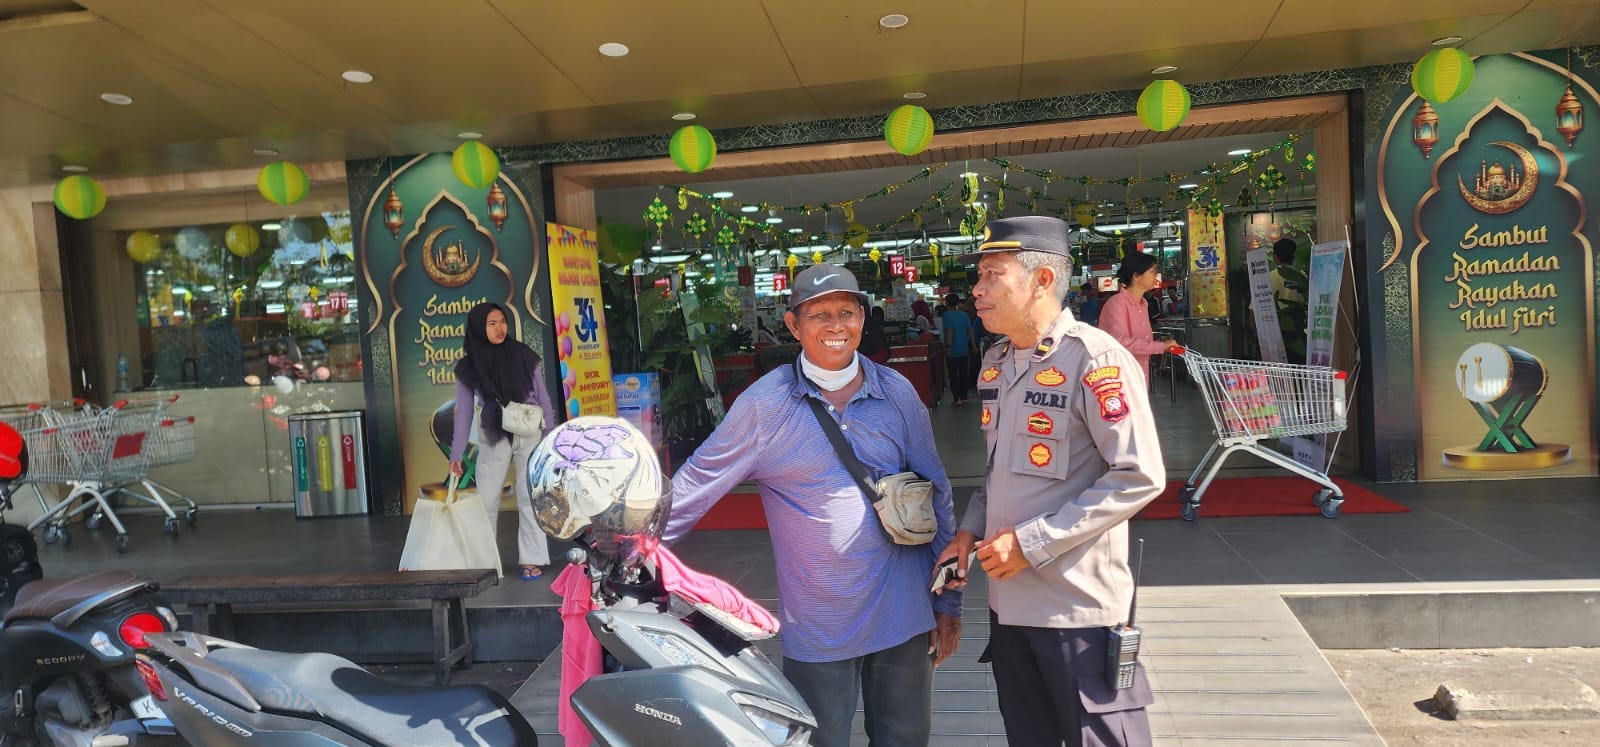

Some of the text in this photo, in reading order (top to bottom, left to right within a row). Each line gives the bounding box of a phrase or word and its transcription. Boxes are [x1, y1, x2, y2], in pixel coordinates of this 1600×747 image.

[1460, 223, 1548, 249] Sambut
[892, 262, 903, 274] 12
[907, 271, 914, 281] 2
[1444, 252, 1560, 281] Ramadan
[423, 293, 487, 317] Samb
[1448, 279, 1558, 309] Rayakan
[414, 317, 466, 344] Rama
[574, 297, 598, 342] 34
[1460, 307, 1508, 331] Idul
[418, 340, 468, 367] Raya
[427, 366, 457, 385] Idu
[1023, 390, 1068, 409] POLRI
[36, 654, 85, 665] SCOOPY
[142, 699, 153, 713] K
[173, 686, 228, 725] VARIO
[633, 703, 682, 726] HONDA
